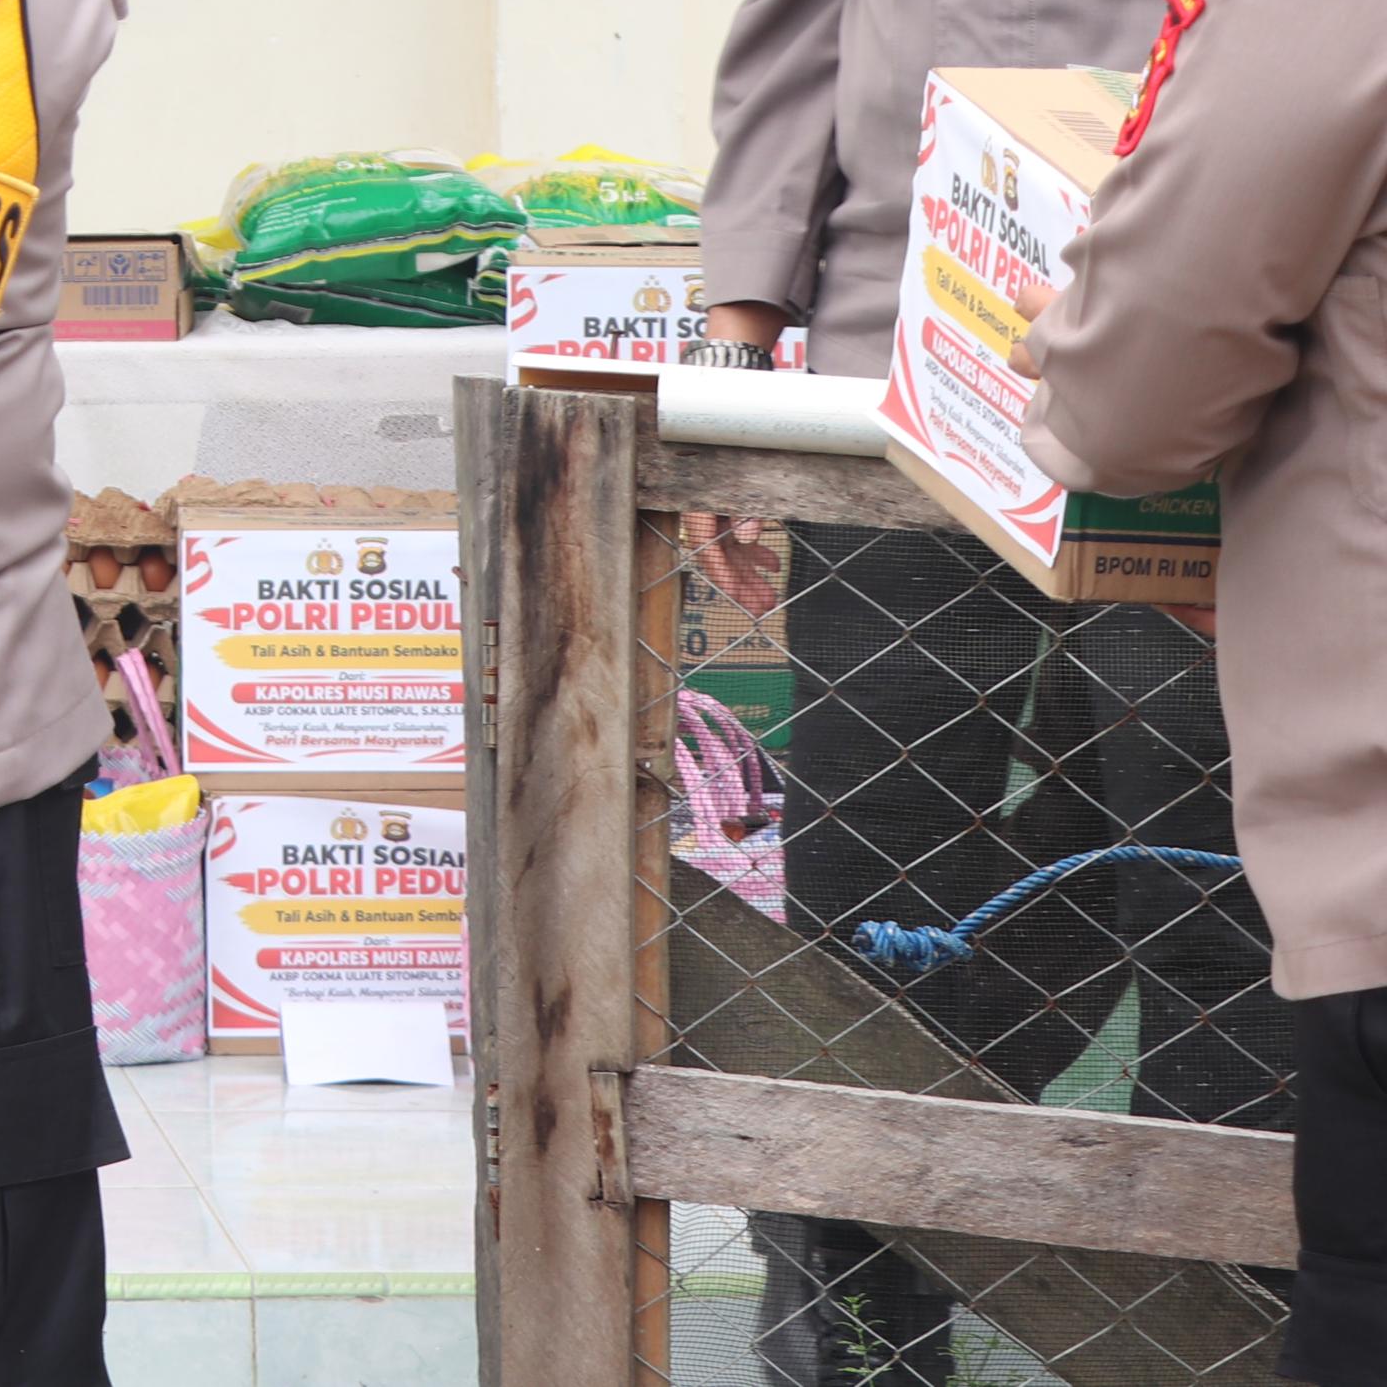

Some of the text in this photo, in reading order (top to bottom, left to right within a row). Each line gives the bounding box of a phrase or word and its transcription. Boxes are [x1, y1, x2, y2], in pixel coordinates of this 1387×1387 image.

[598, 181, 619, 203] 5
[951, 171, 1050, 277] BAKTI SOSIAL
[932, 197, 991, 279] POLRI
[584, 317, 667, 339] BAKTI
[1138, 497, 1217, 516] CHICKEN
[1094, 555, 1212, 579] BPOM RI MD
[257, 579, 448, 601] BAKTI SOSIAL
[232, 602, 462, 631] POLRI PEDUL
[250, 644, 459, 658] Tali Asih & Bantuan Sembako
[255, 685, 452, 701] KAPOLRES MUSI RAWAS
[244, 706, 274, 716] AKBP
[277, 706, 318, 716] GOKMA
[265, 735, 445, 748] Polri Bersama Masyarakat
[282, 844, 364, 865] BAKTI
[257, 868, 465, 896] POLRI PEDU
[275, 910, 462, 923] Tali Asih & Bantuan Semba
[280, 951, 463, 966] KAPOLRES MUSI RAWA
[269, 972, 300, 982] AKBP
